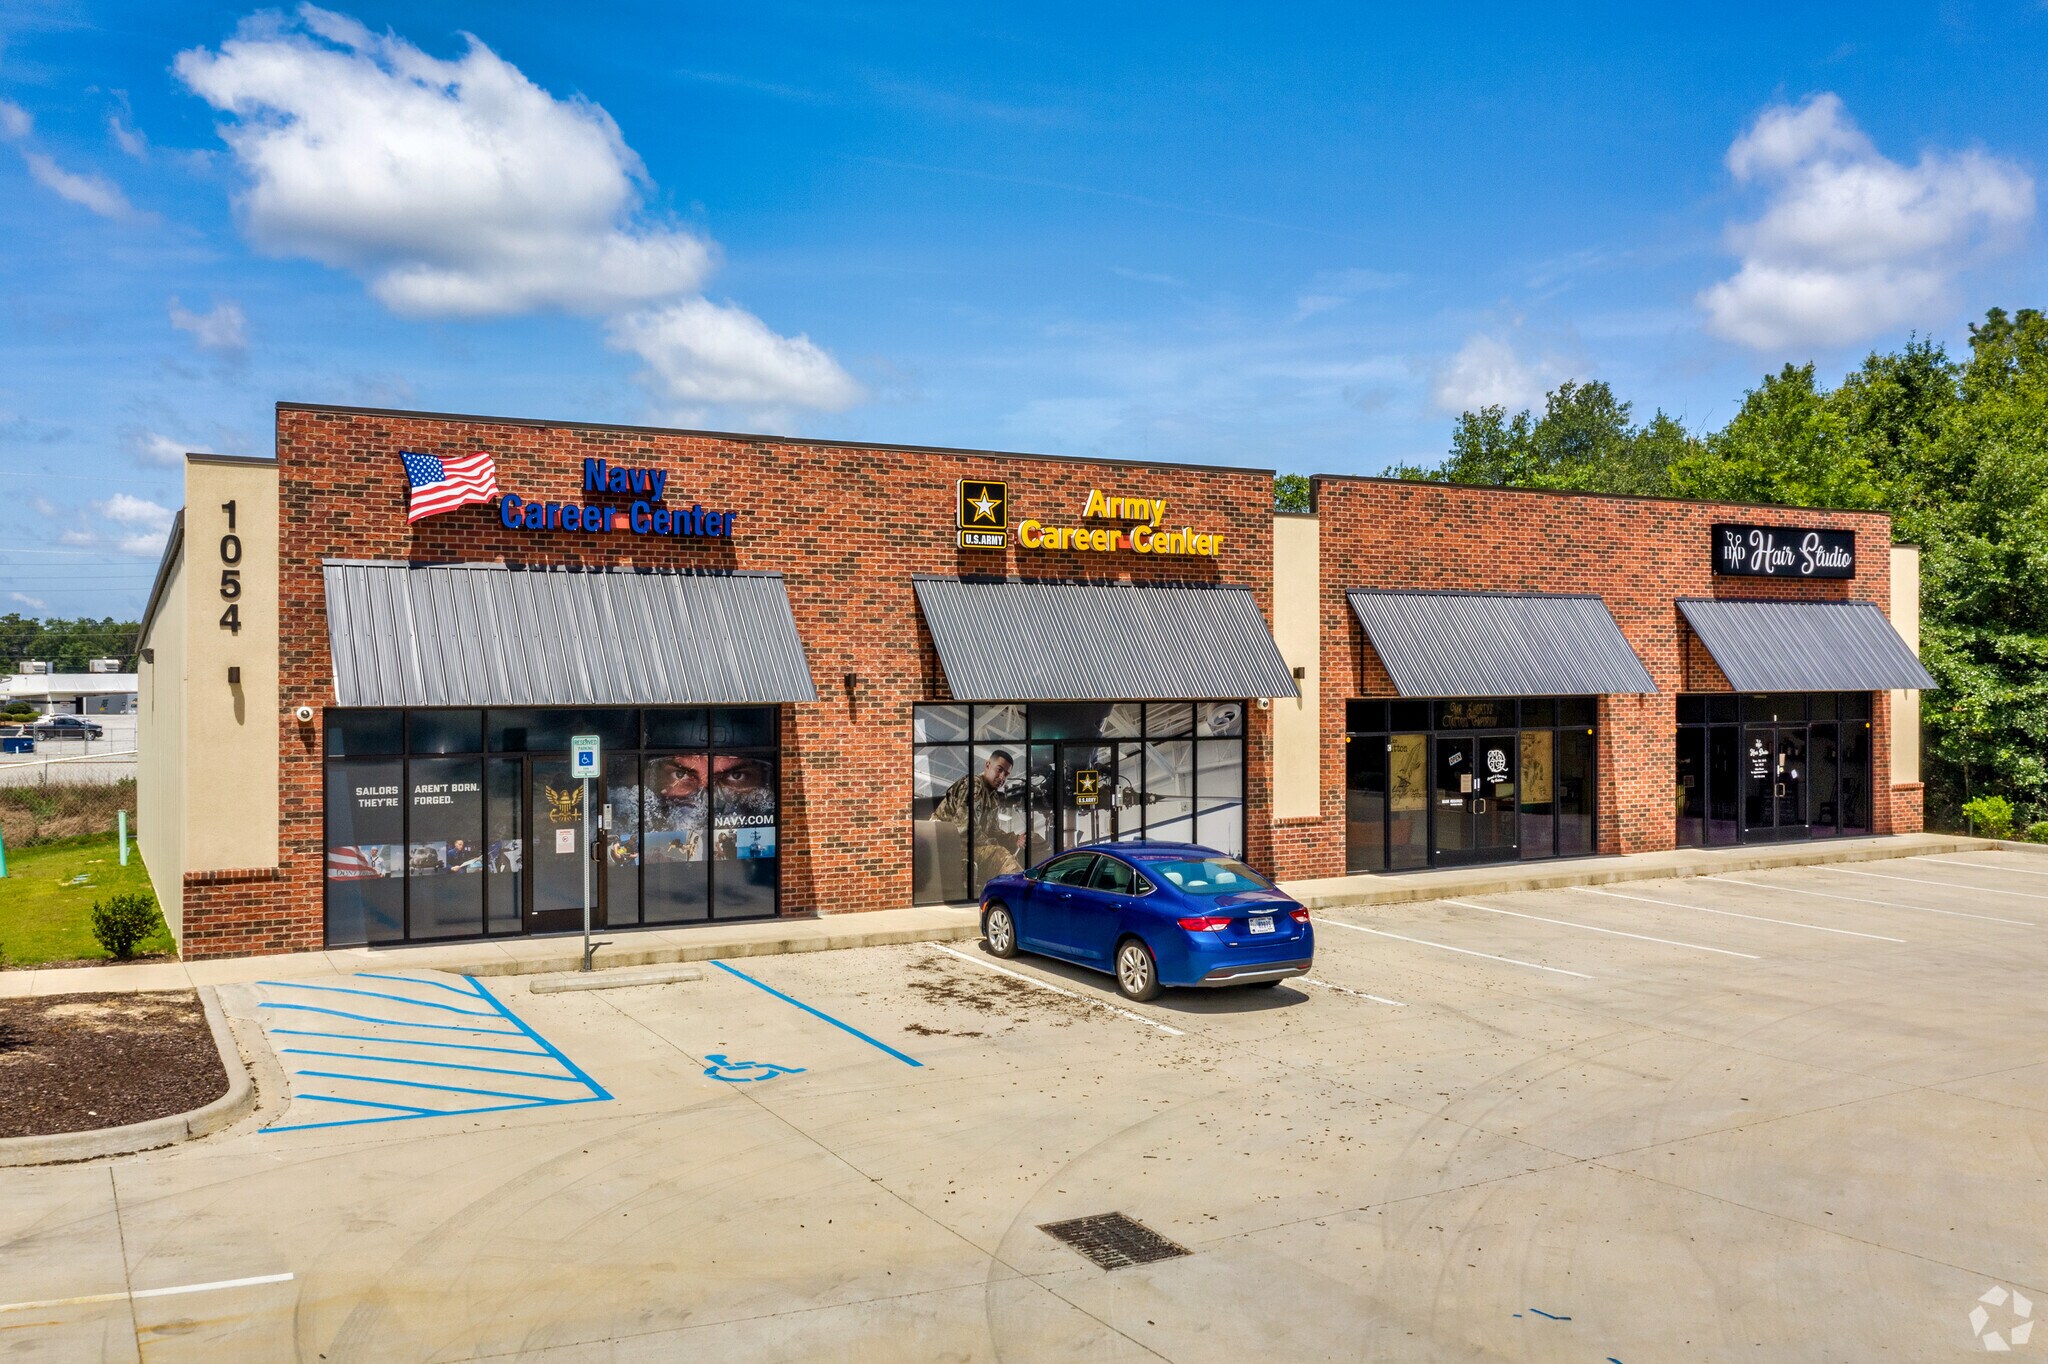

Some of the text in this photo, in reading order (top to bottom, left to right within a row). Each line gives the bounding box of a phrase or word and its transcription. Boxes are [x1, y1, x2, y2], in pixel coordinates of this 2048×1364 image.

[583, 458, 667, 500] Navy
[500, 494, 736, 537] Career Center
[1082, 489, 1166, 527] Army
[1018, 519, 1224, 557] Career Center
[1749, 529, 1796, 573] Hair
[1799, 532, 1852, 575] Studio
[219, 499, 242, 634] 1054
[355, 782, 480, 796] SAILORS AREN'T BORN.
[357, 795, 454, 808] THEY'RE FORGED.
[714, 815, 774, 826] NAVY.COM
